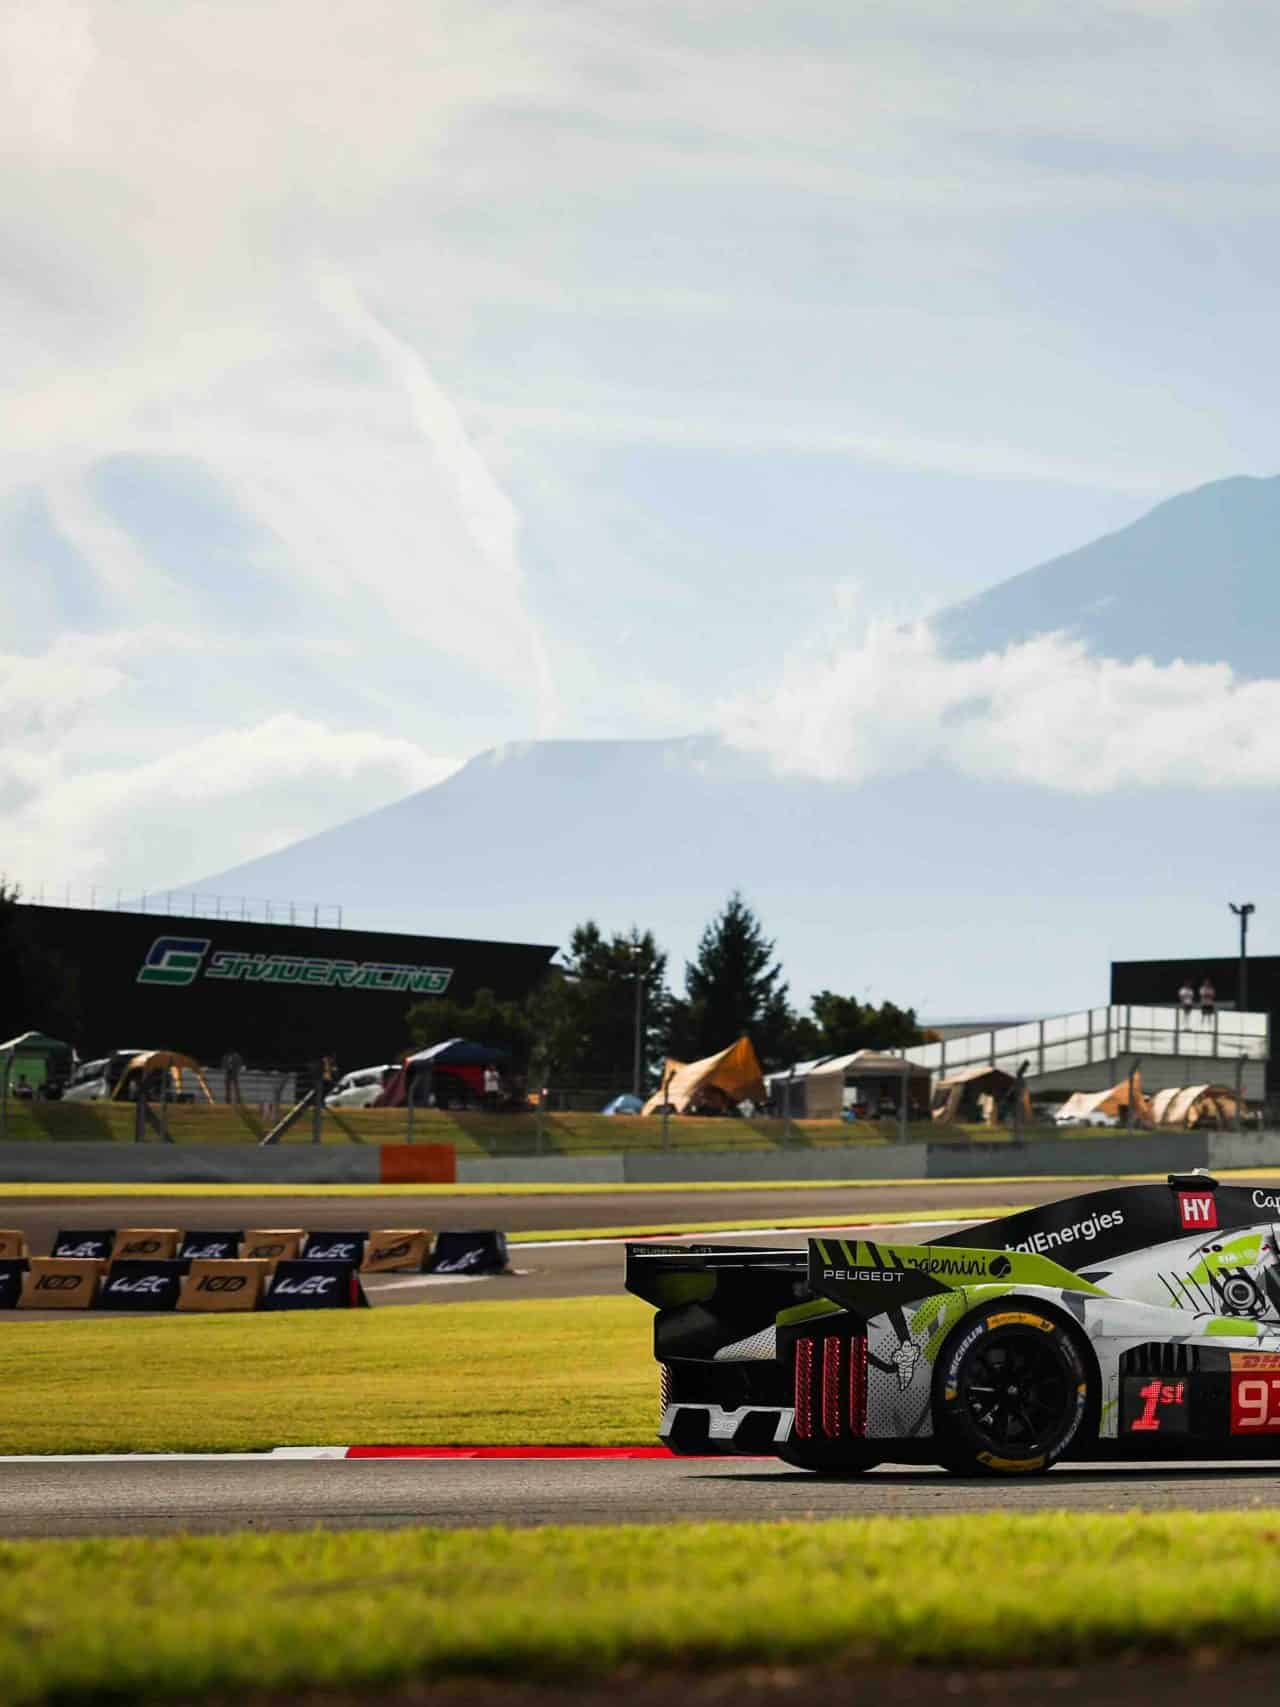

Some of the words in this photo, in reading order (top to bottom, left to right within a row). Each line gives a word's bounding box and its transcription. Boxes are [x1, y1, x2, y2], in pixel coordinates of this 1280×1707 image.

[1183, 1198, 1211, 1221] HY
[1005, 1209, 1125, 1254] talEnergies
[307, 1243, 356, 1259] WEC
[109, 1275, 169, 1293] WEC
[274, 1275, 337, 1294] WEC
[823, 1269, 904, 1283] PEUGEOT
[949, 1323, 984, 1376] MICHELIN
[1131, 1378, 1185, 1431] 1st
